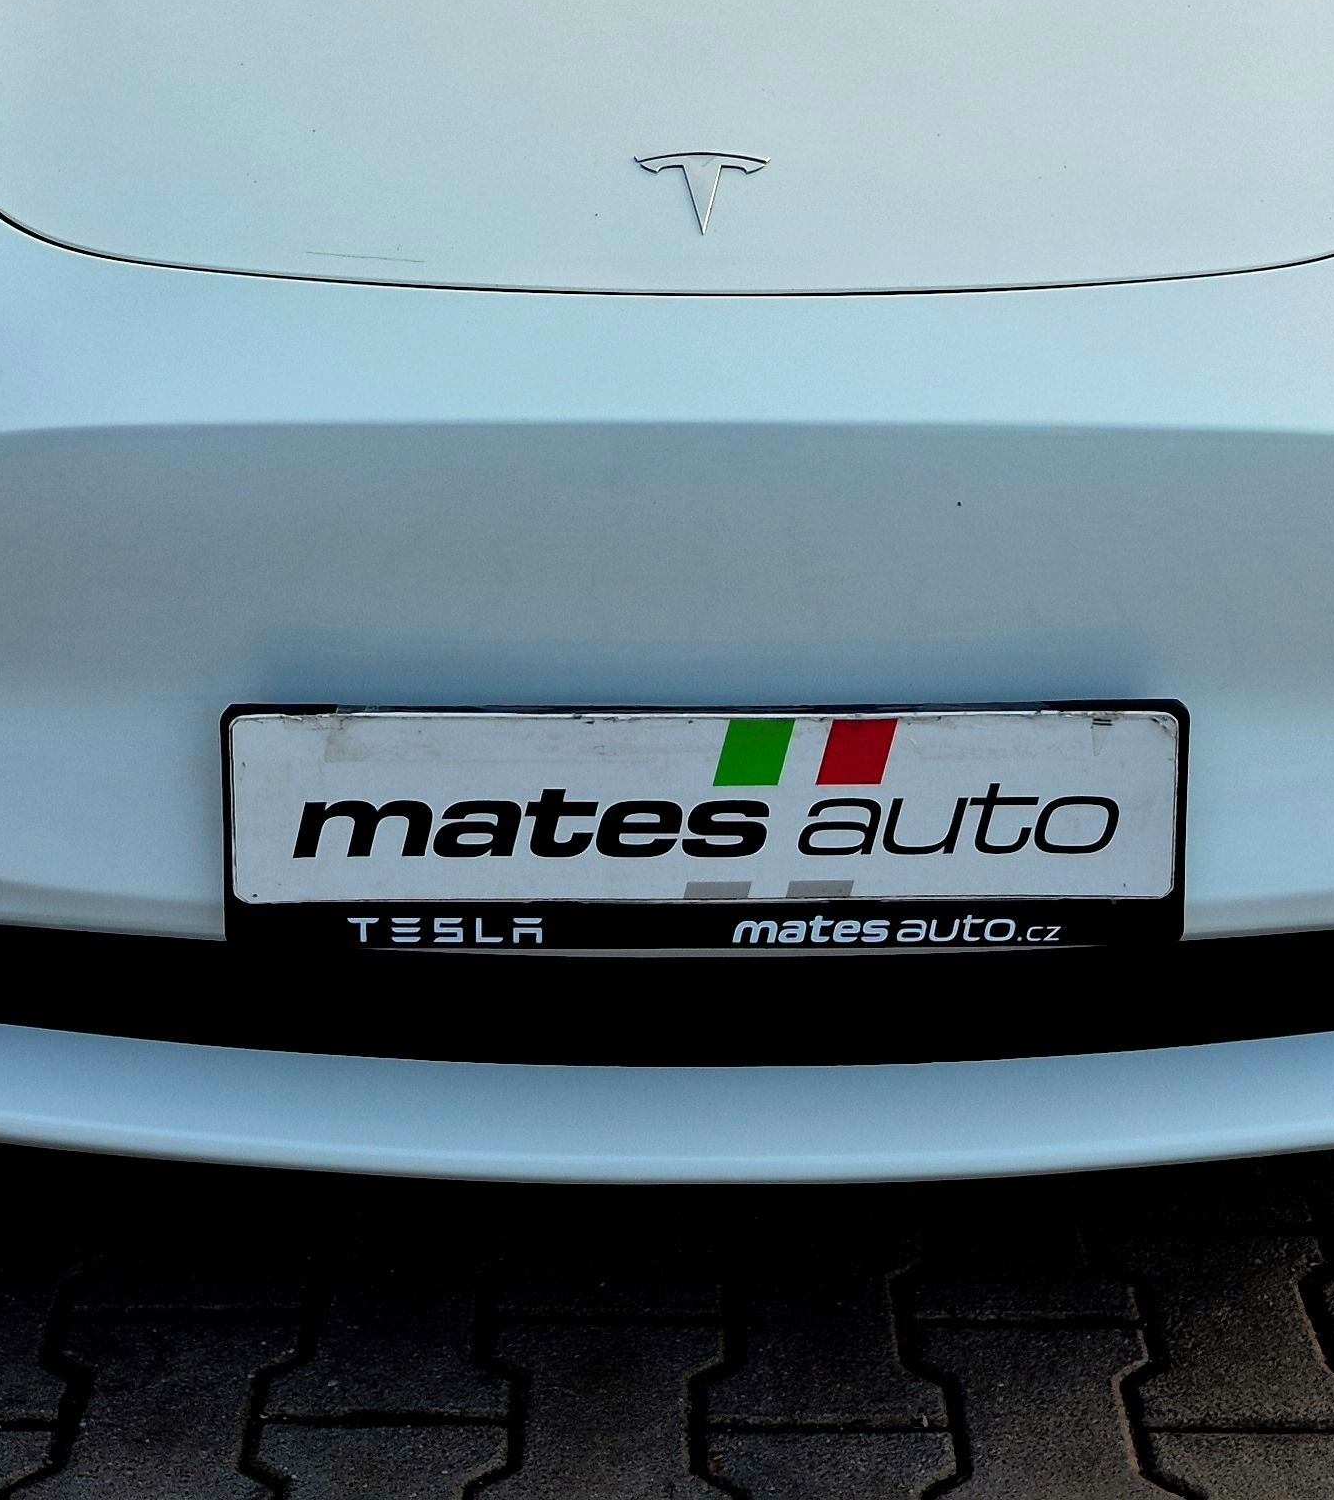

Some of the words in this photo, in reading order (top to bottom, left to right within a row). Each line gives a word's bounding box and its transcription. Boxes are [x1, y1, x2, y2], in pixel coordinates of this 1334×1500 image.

[293, 787, 770, 859] mates
[796, 782, 1121, 856] auto
[347, 917, 543, 944] TESLA
